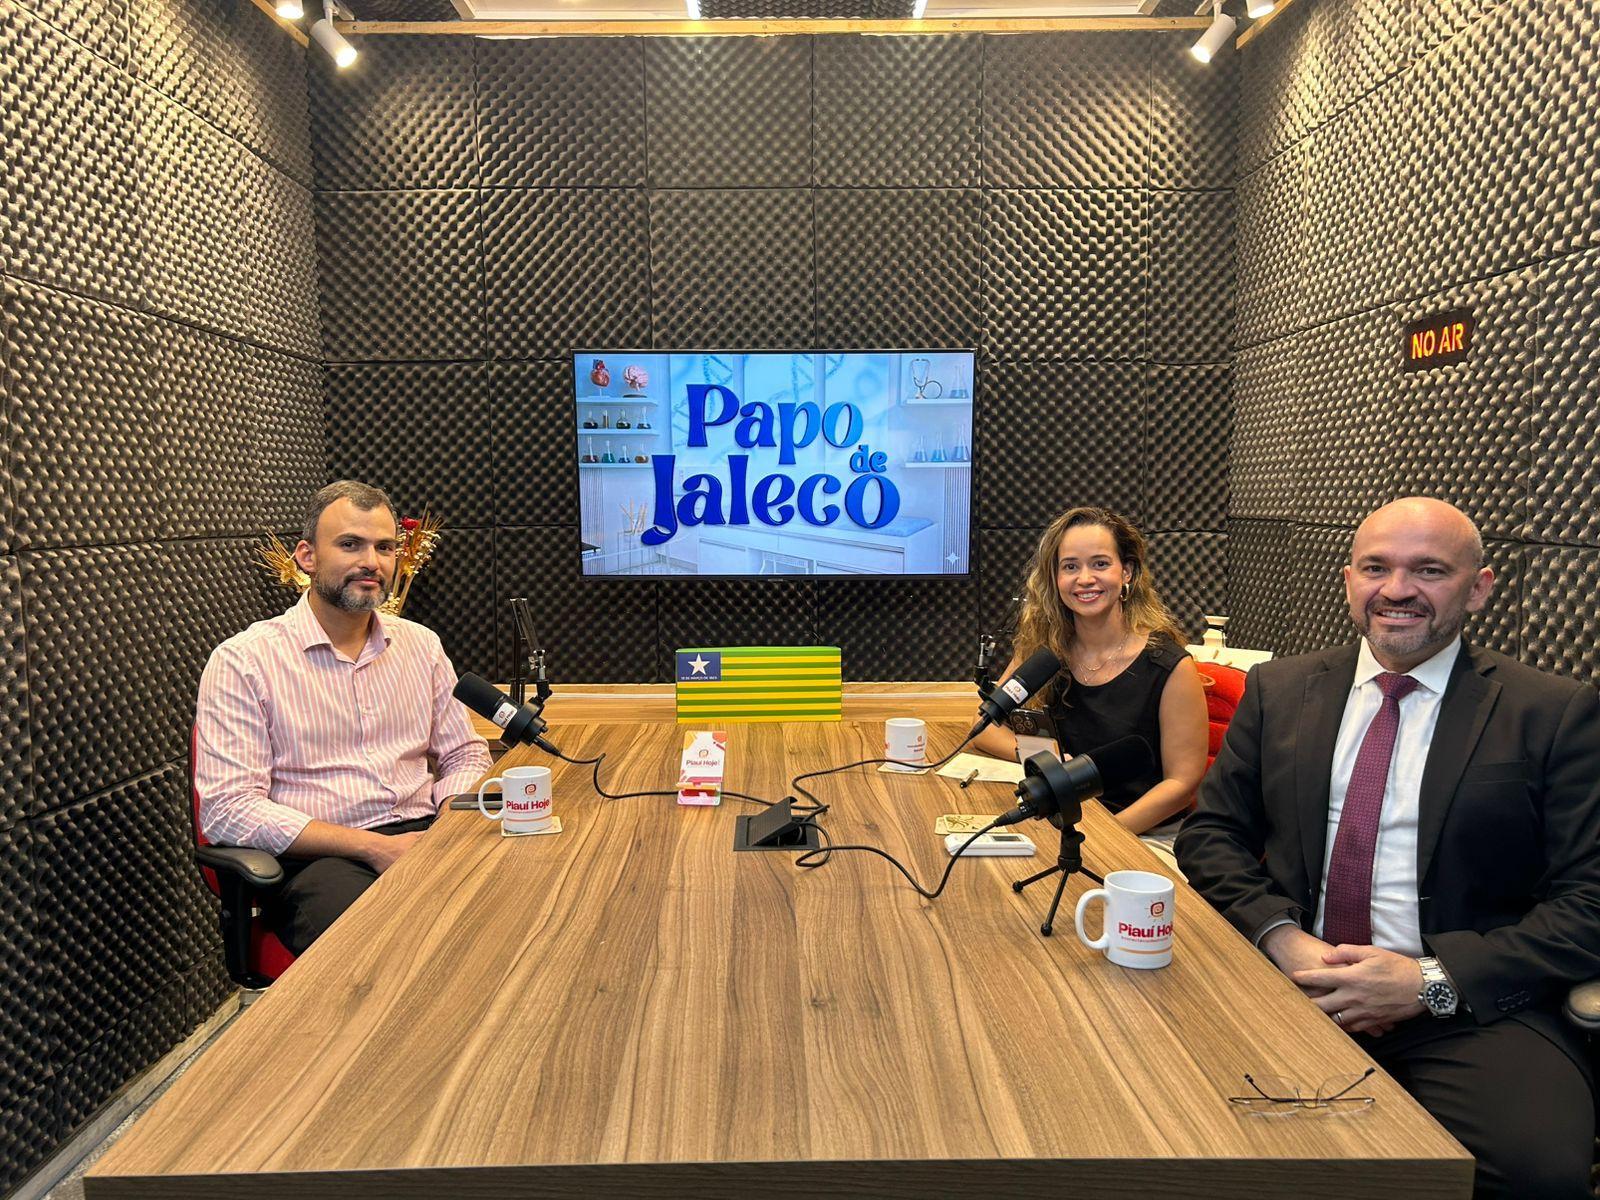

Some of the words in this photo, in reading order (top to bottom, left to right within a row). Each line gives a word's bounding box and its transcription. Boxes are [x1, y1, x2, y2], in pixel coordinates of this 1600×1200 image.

[1411, 329, 1436, 360] NO
[1438, 322, 1464, 354] AR
[686, 383, 864, 465] Papo
[849, 444, 888, 473] de
[640, 454, 901, 546] Jaleco
[506, 800, 529, 810] Piauí
[1118, 922, 1154, 938] Piauí
